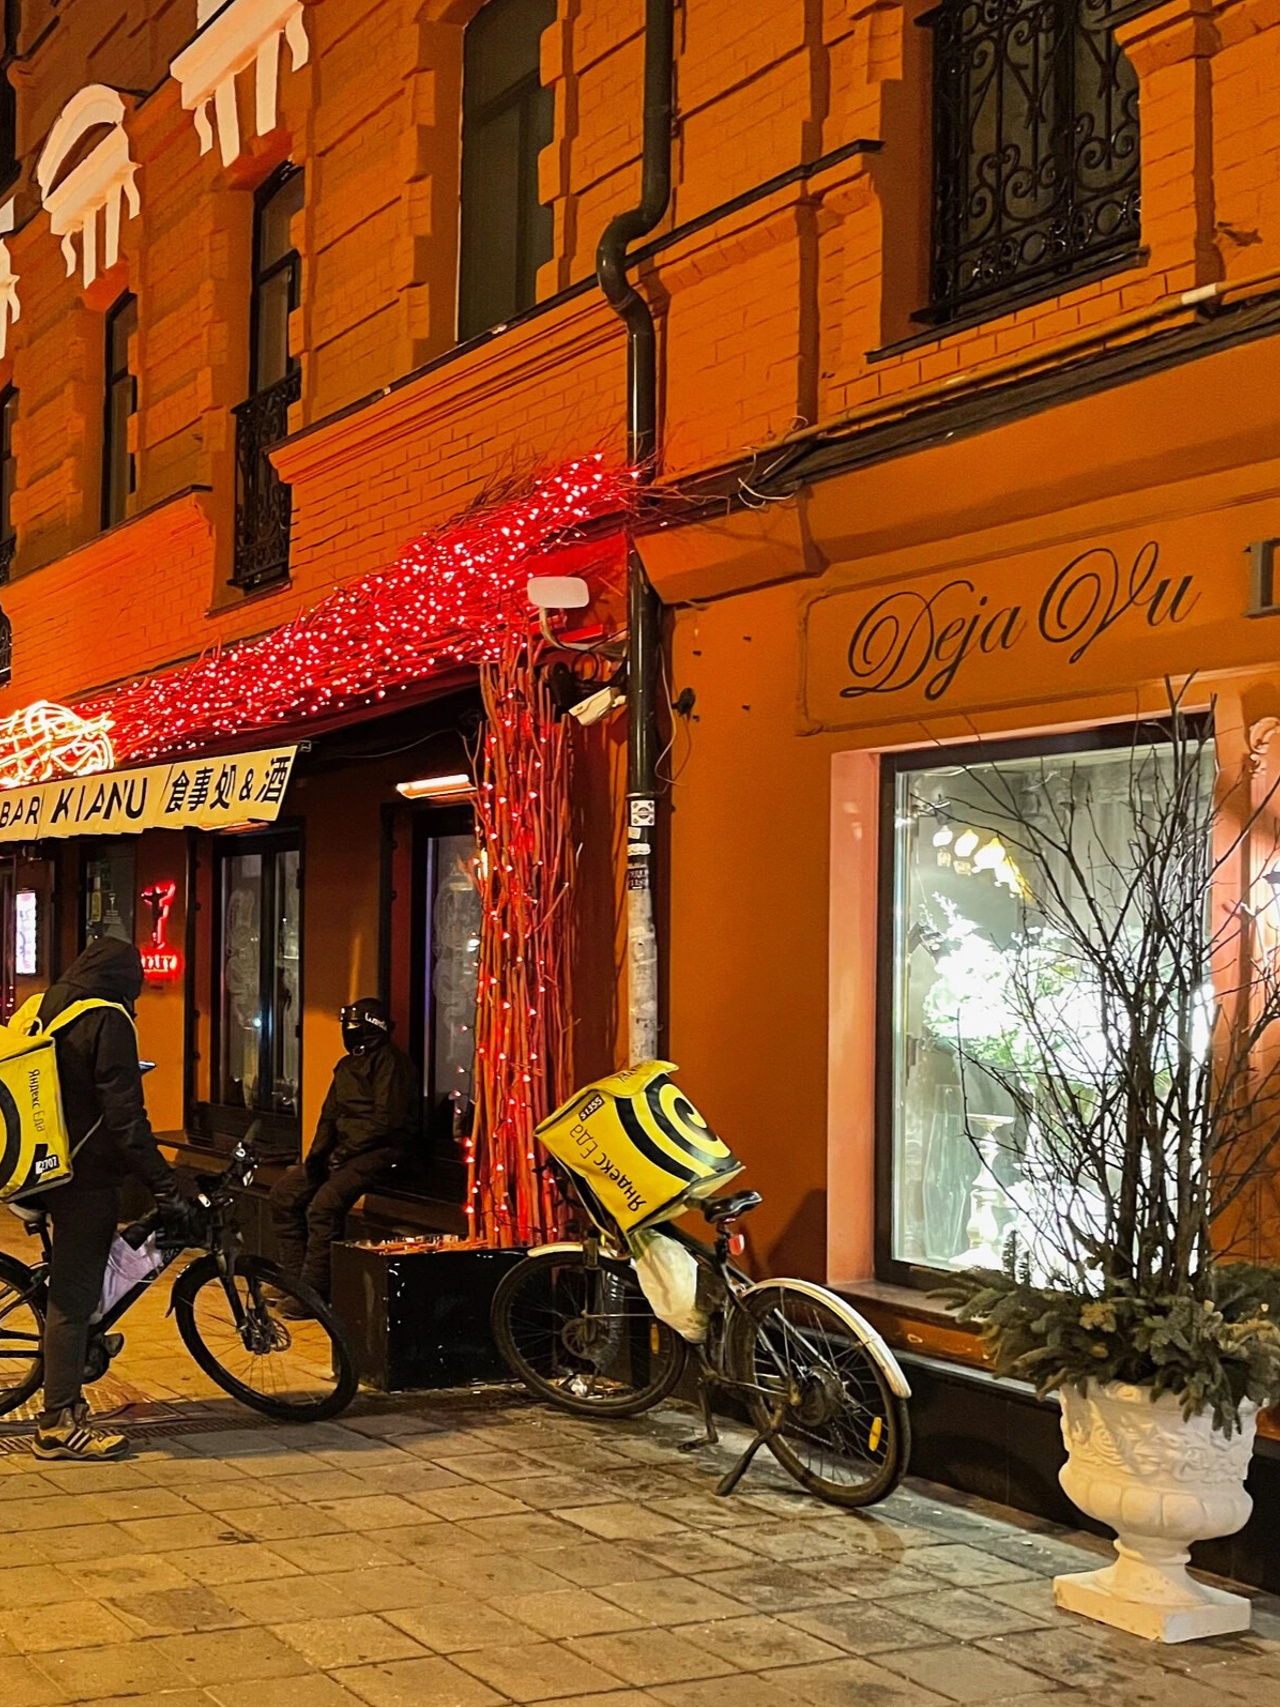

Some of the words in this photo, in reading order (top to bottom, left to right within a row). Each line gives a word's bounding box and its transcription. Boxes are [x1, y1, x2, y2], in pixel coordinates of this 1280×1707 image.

[839, 580, 1027, 700] Deja
[1038, 541, 1202, 664] Vu
[50, 777, 148, 824] KIANU
[569, 1123, 599, 1160] Еда
[593, 1152, 647, 1213] Яндекс
